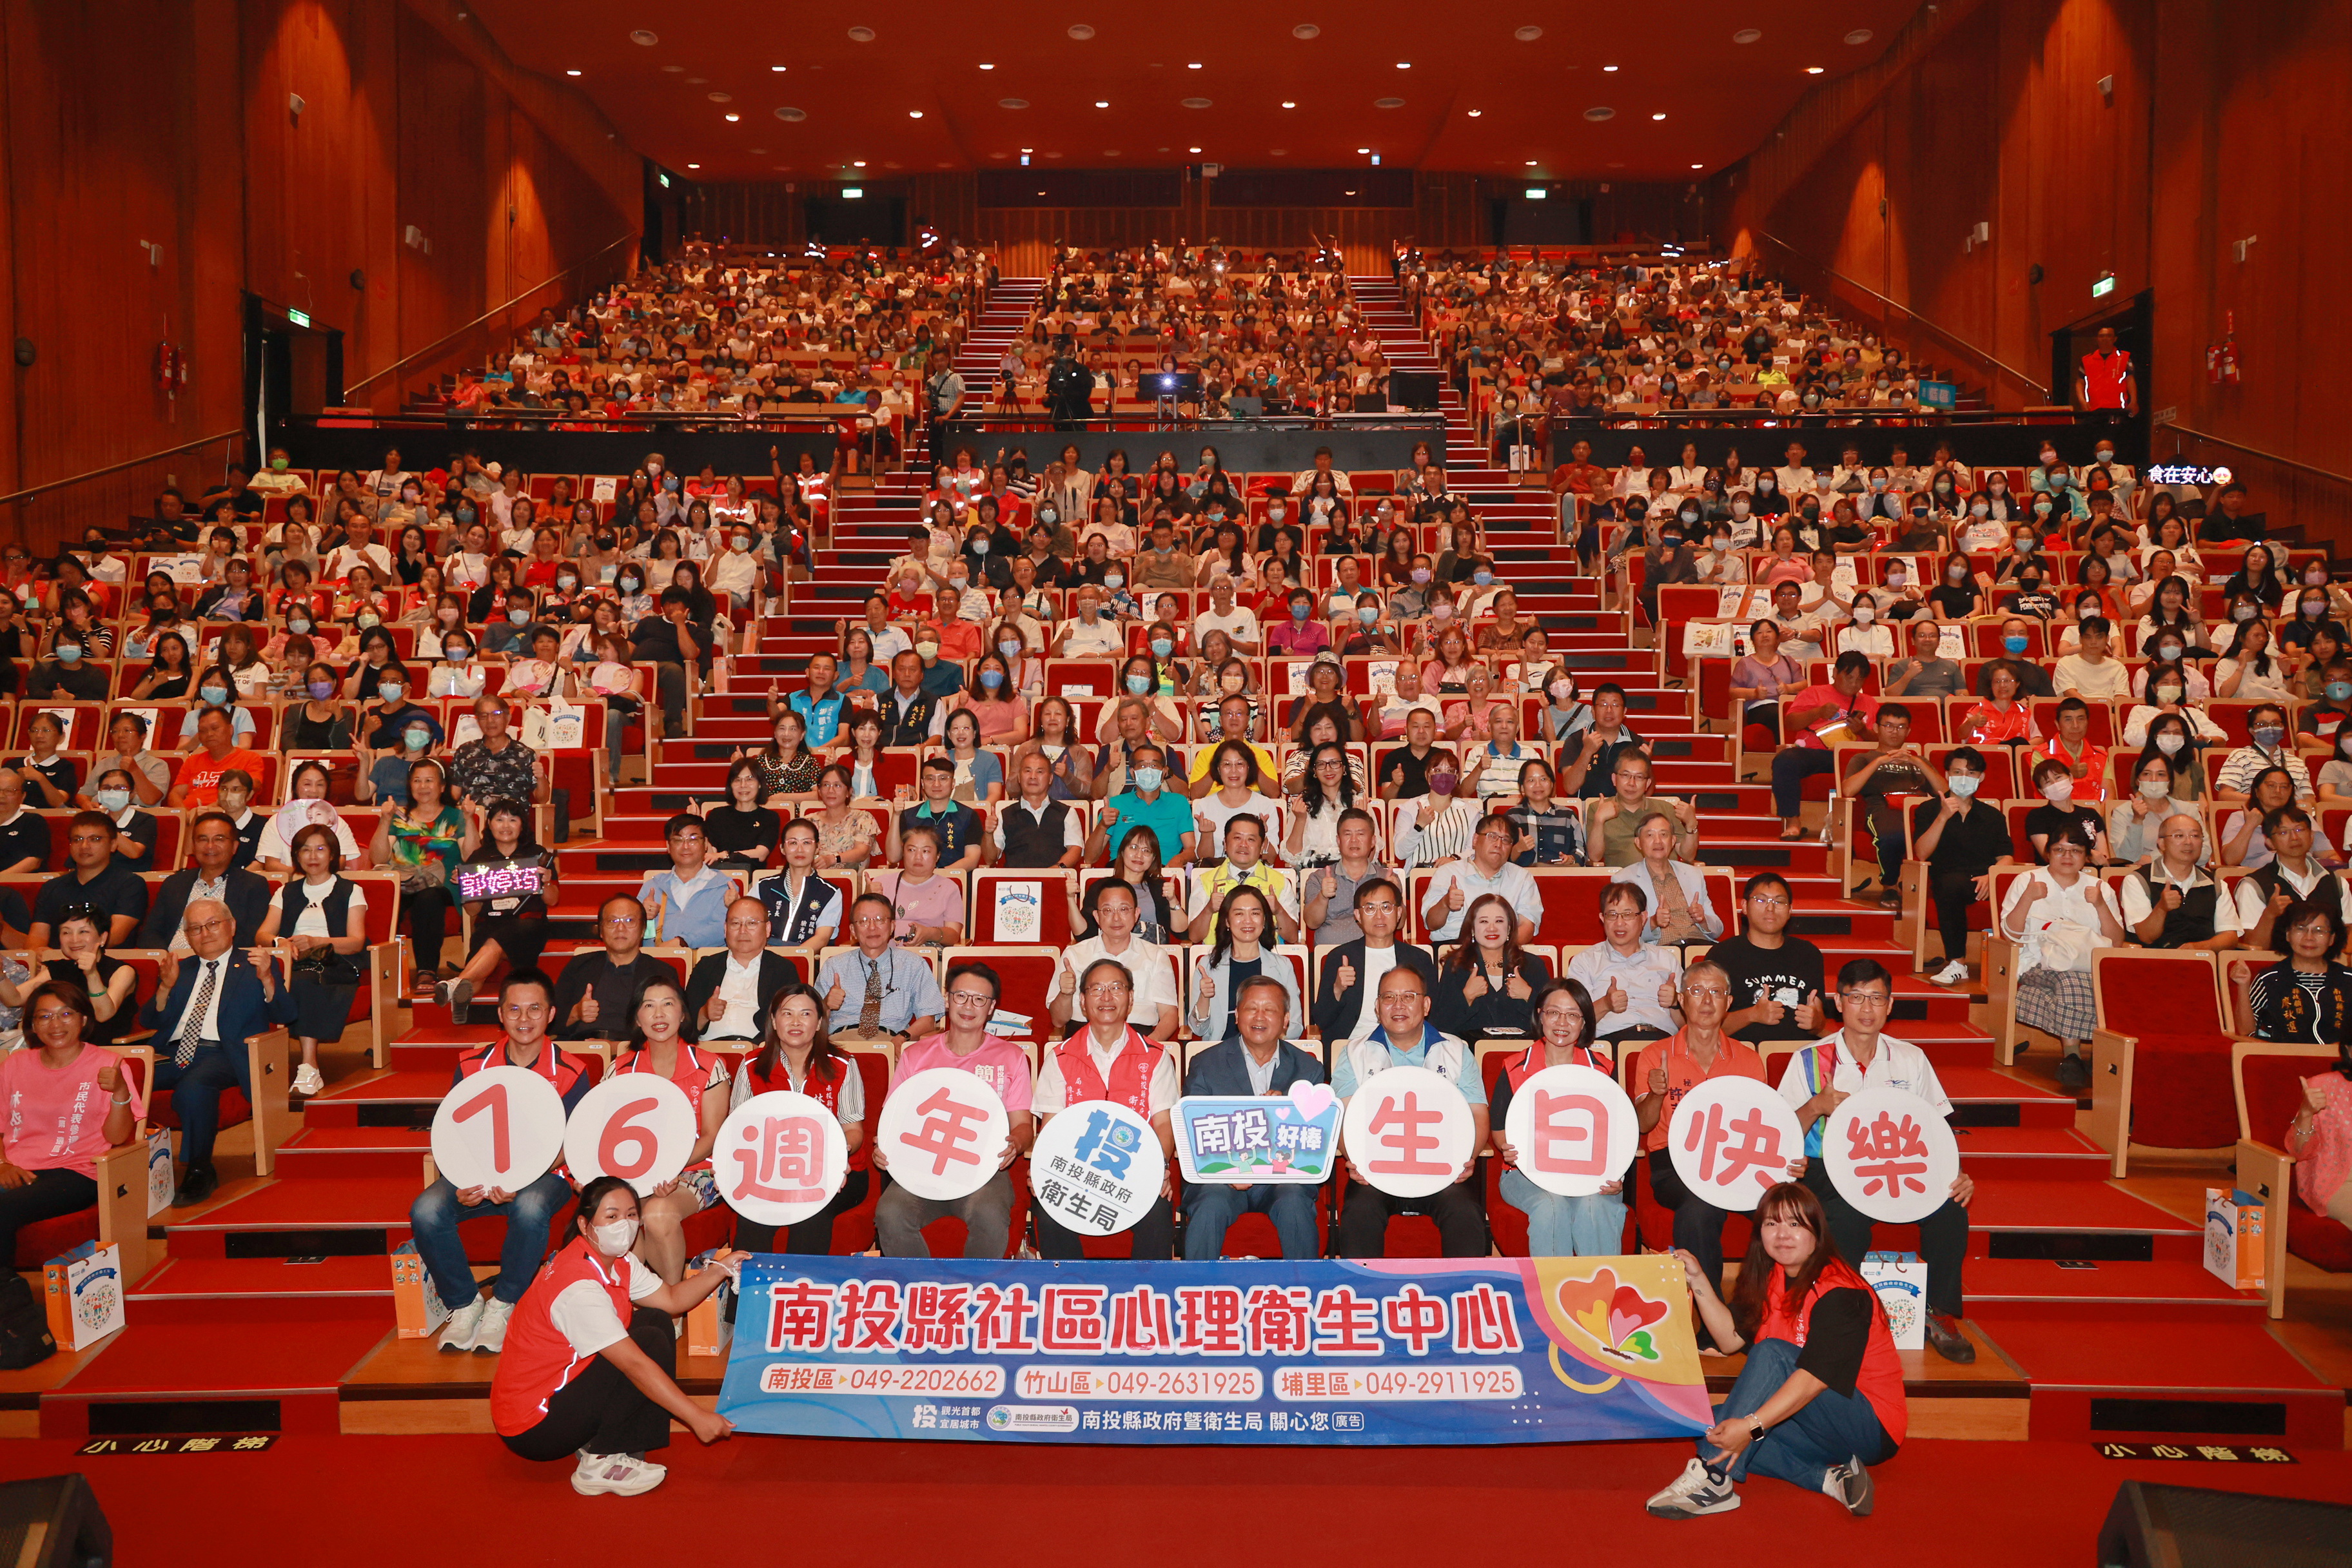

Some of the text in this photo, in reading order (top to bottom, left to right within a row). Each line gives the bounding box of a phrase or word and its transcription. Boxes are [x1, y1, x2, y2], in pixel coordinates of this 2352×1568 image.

[2148, 464, 2215, 485] 食在安心
[798, 920, 807, 943] 驗光師
[808, 914, 817, 934] 南投縣
[1745, 974, 1806, 990] SUMMER
[974, 1064, 995, 1083] 簡
[1075, 1077, 1083, 1097] 局長
[63, 1082, 92, 1155] 市民代表參選人
[452, 1083, 511, 1174] 1
[899, 1086, 990, 1176] 年
[598, 1097, 659, 1180] 6
[1193, 1108, 1323, 1155] 南投 好棒
[1369, 1091, 1453, 1176] 生
[1534, 1089, 1609, 1176] 日
[1684, 1101, 1787, 1191] 快
[1847, 1110, 1929, 1199] 樂
[732, 1117, 825, 1203] 週
[1050, 1155, 1133, 1204] 南投縣政府
[1039, 1179, 1119, 1232] 衛生局
[770, 1282, 1520, 1352] 南投縣社區心理衛生中心
[767, 1367, 997, 1392] 南投區 049-2202662
[1024, 1370, 1256, 1395] 竹山區 049-2631925
[1282, 1371, 1515, 1396] 埔里區 049-2911925
[939, 1418, 980, 1429] 宜居城市
[941, 1406, 981, 1416] 觀光首都
[1083, 1410, 1362, 1431] 南投縣政府暨衛生局 關心您 廣告
[83, 1436, 270, 1454] 小心階梯
[2103, 1443, 2290, 1462] 小心階梯
